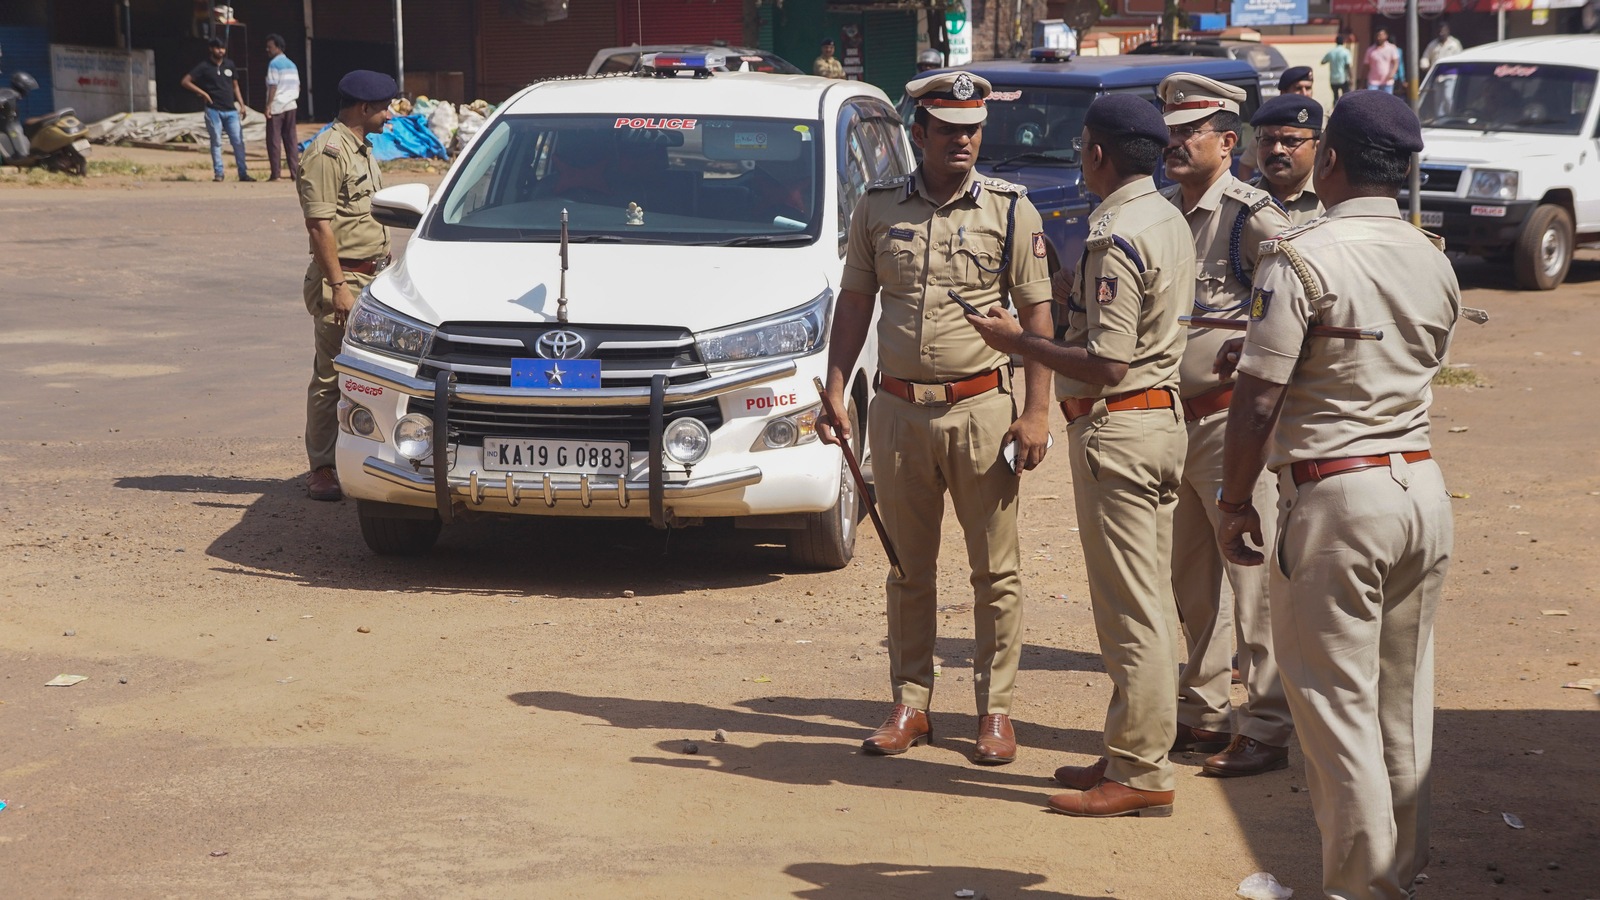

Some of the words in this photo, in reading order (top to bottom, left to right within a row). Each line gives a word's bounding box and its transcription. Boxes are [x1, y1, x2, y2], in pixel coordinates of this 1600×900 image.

[614, 118, 697, 130] POLICE
[1472, 207, 1503, 215] POLICE
[746, 393, 797, 410] POLICE
[486, 450, 498, 458] IND
[499, 443, 549, 466] KA19
[557, 446, 567, 467] G
[575, 447, 625, 469] 0883
